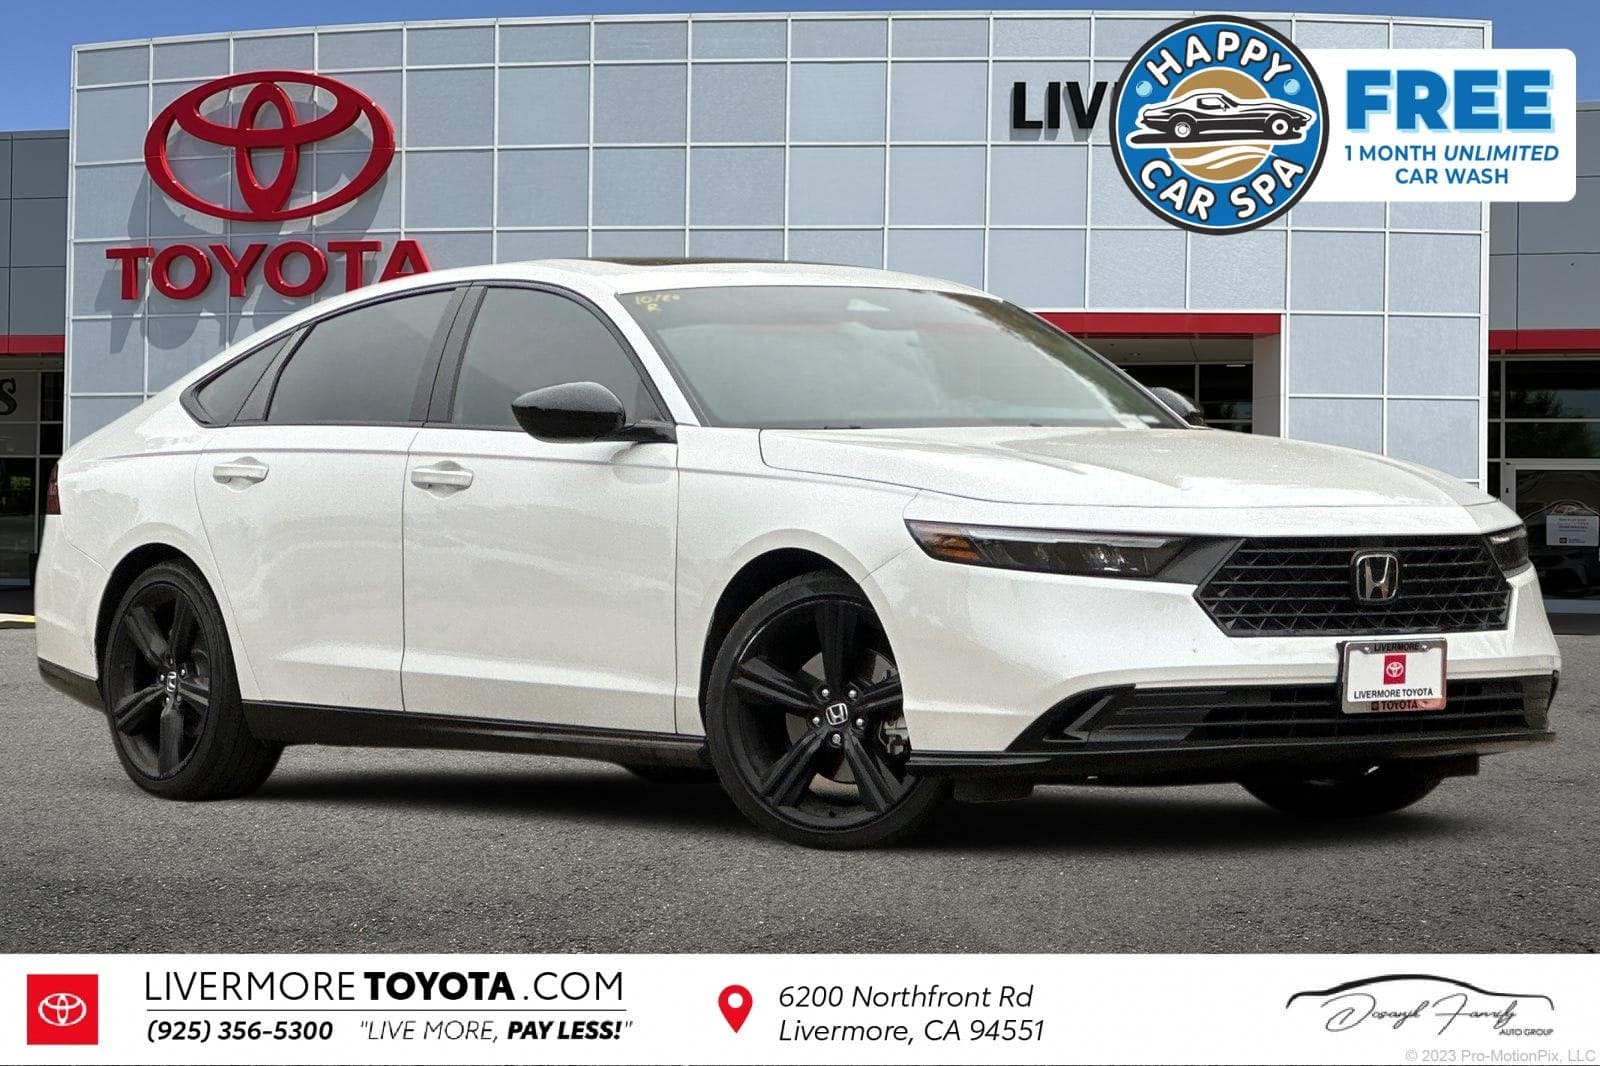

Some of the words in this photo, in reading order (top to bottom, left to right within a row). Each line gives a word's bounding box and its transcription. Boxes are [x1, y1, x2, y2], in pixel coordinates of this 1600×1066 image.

[1013, 81, 1119, 129] LIV
[106, 240, 431, 300] TOYOTA
[1374, 642, 1419, 652] LIVERMORE
[1353, 689, 1401, 699] LIVERMORE
[1402, 688, 1433, 697] TOYOTA
[1381, 700, 1418, 710] TOYOTA
